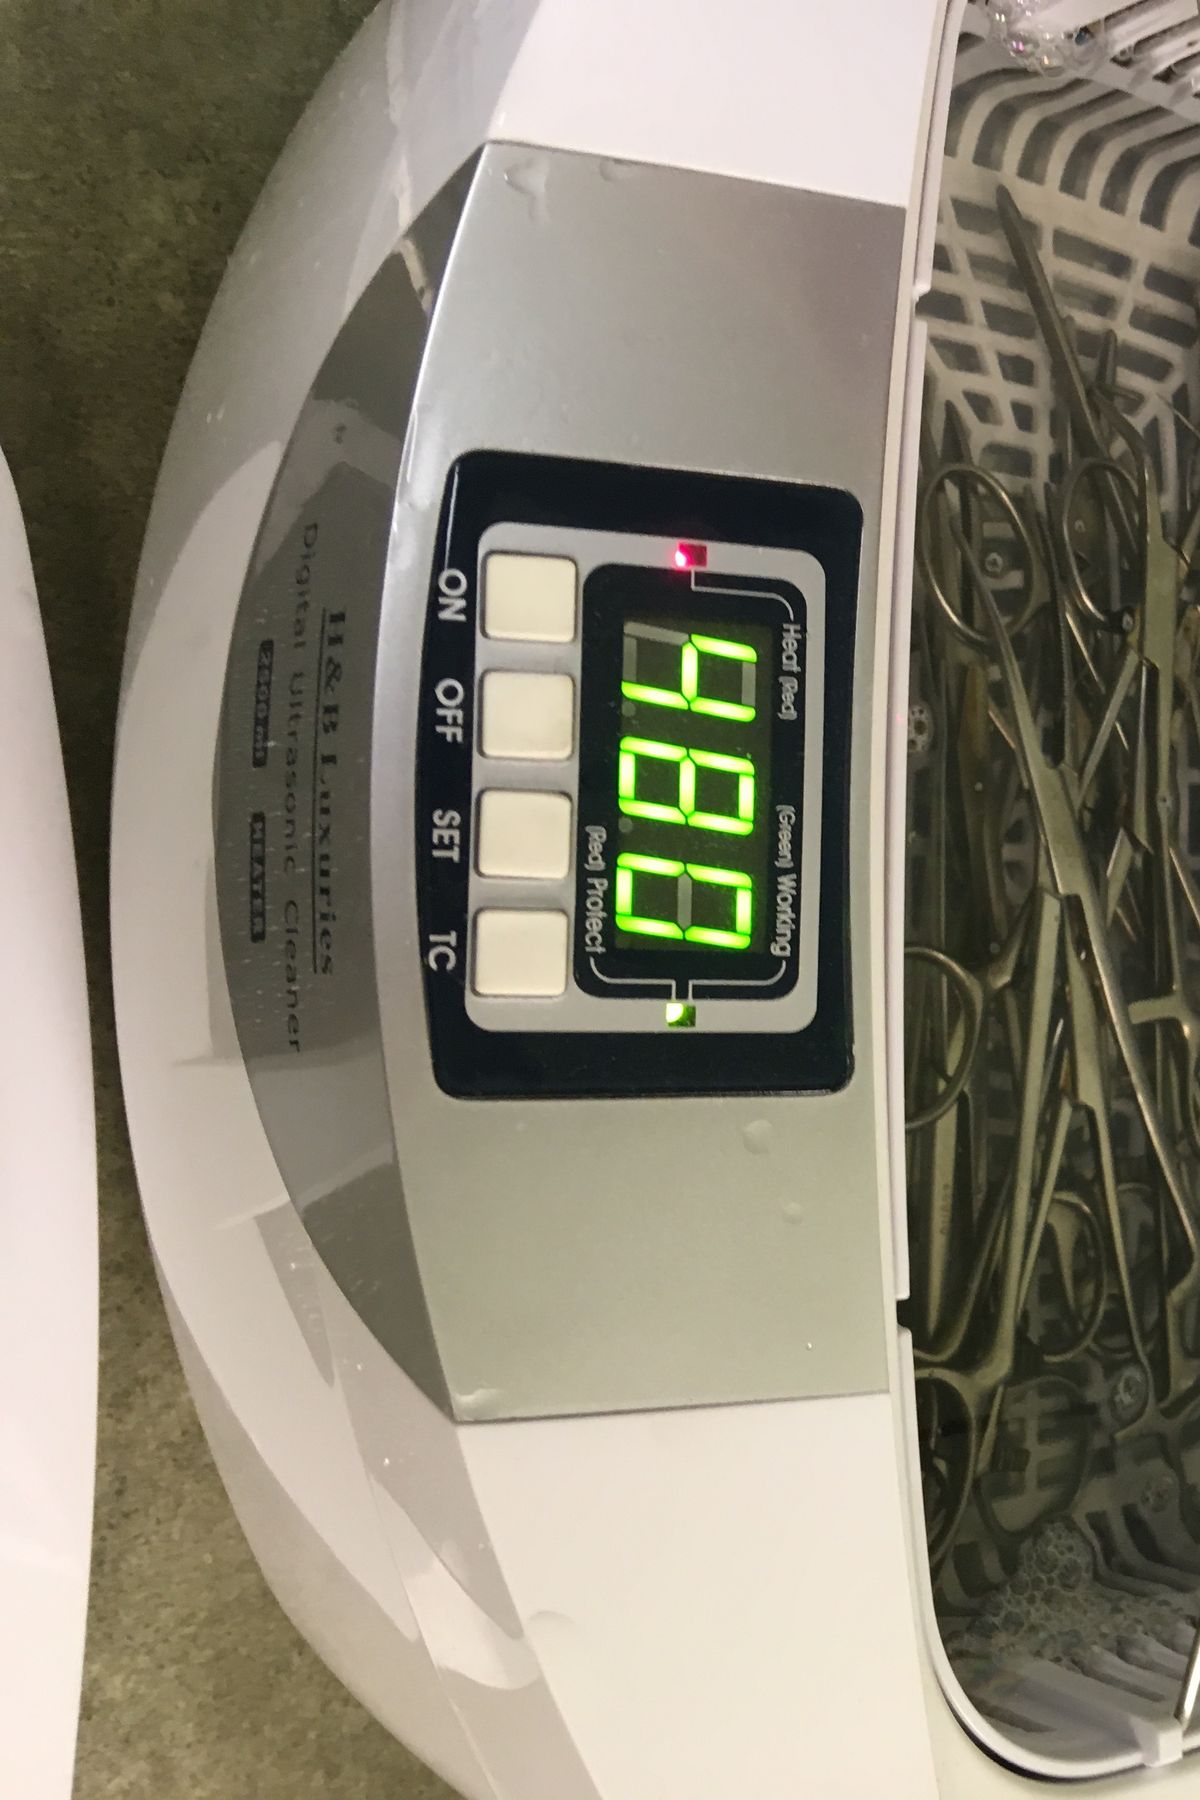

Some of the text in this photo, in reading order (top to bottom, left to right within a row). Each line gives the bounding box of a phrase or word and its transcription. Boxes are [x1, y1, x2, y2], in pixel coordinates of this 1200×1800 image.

[437, 568, 468, 622] ON
[433, 678, 464, 743] OFF
[777, 623, 800, 720] Heat (Red)
[282, 523, 318, 1053] Digital Ultrasonic Cleaner
[318, 611, 346, 975] H&B Luxuries
[431, 808, 461, 863] SET
[614, 634, 757, 949] 480
[251, 820, 264, 935] HEATER
[584, 825, 607, 953] (Red) Protect
[769, 805, 796, 956] (Green) Working
[427, 930, 457, 971] TC
